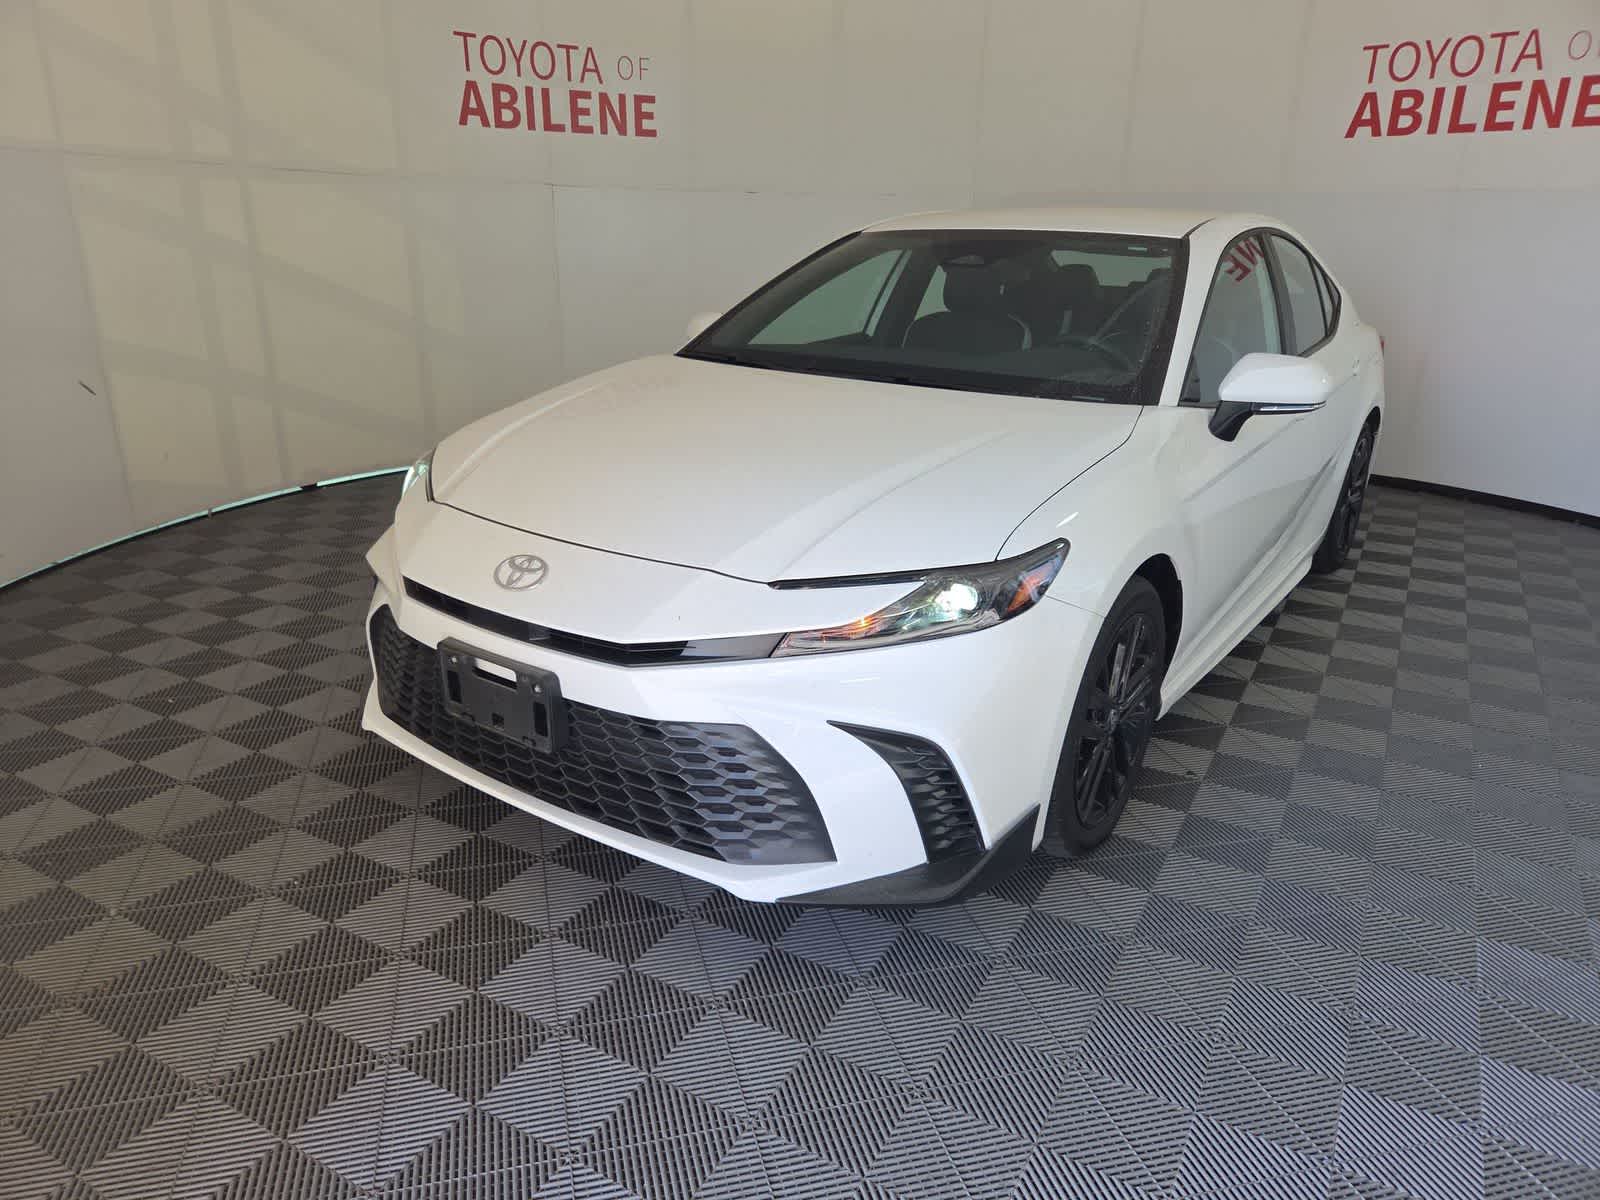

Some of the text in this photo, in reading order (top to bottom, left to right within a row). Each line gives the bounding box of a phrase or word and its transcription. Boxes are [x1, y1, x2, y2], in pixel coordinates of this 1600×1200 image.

[453, 31, 649, 84] TOYOTA OF
[1362, 28, 1600, 84] TOYOTA O
[459, 80, 657, 138] ABILENE
[1344, 74, 1600, 139] ABILENE
